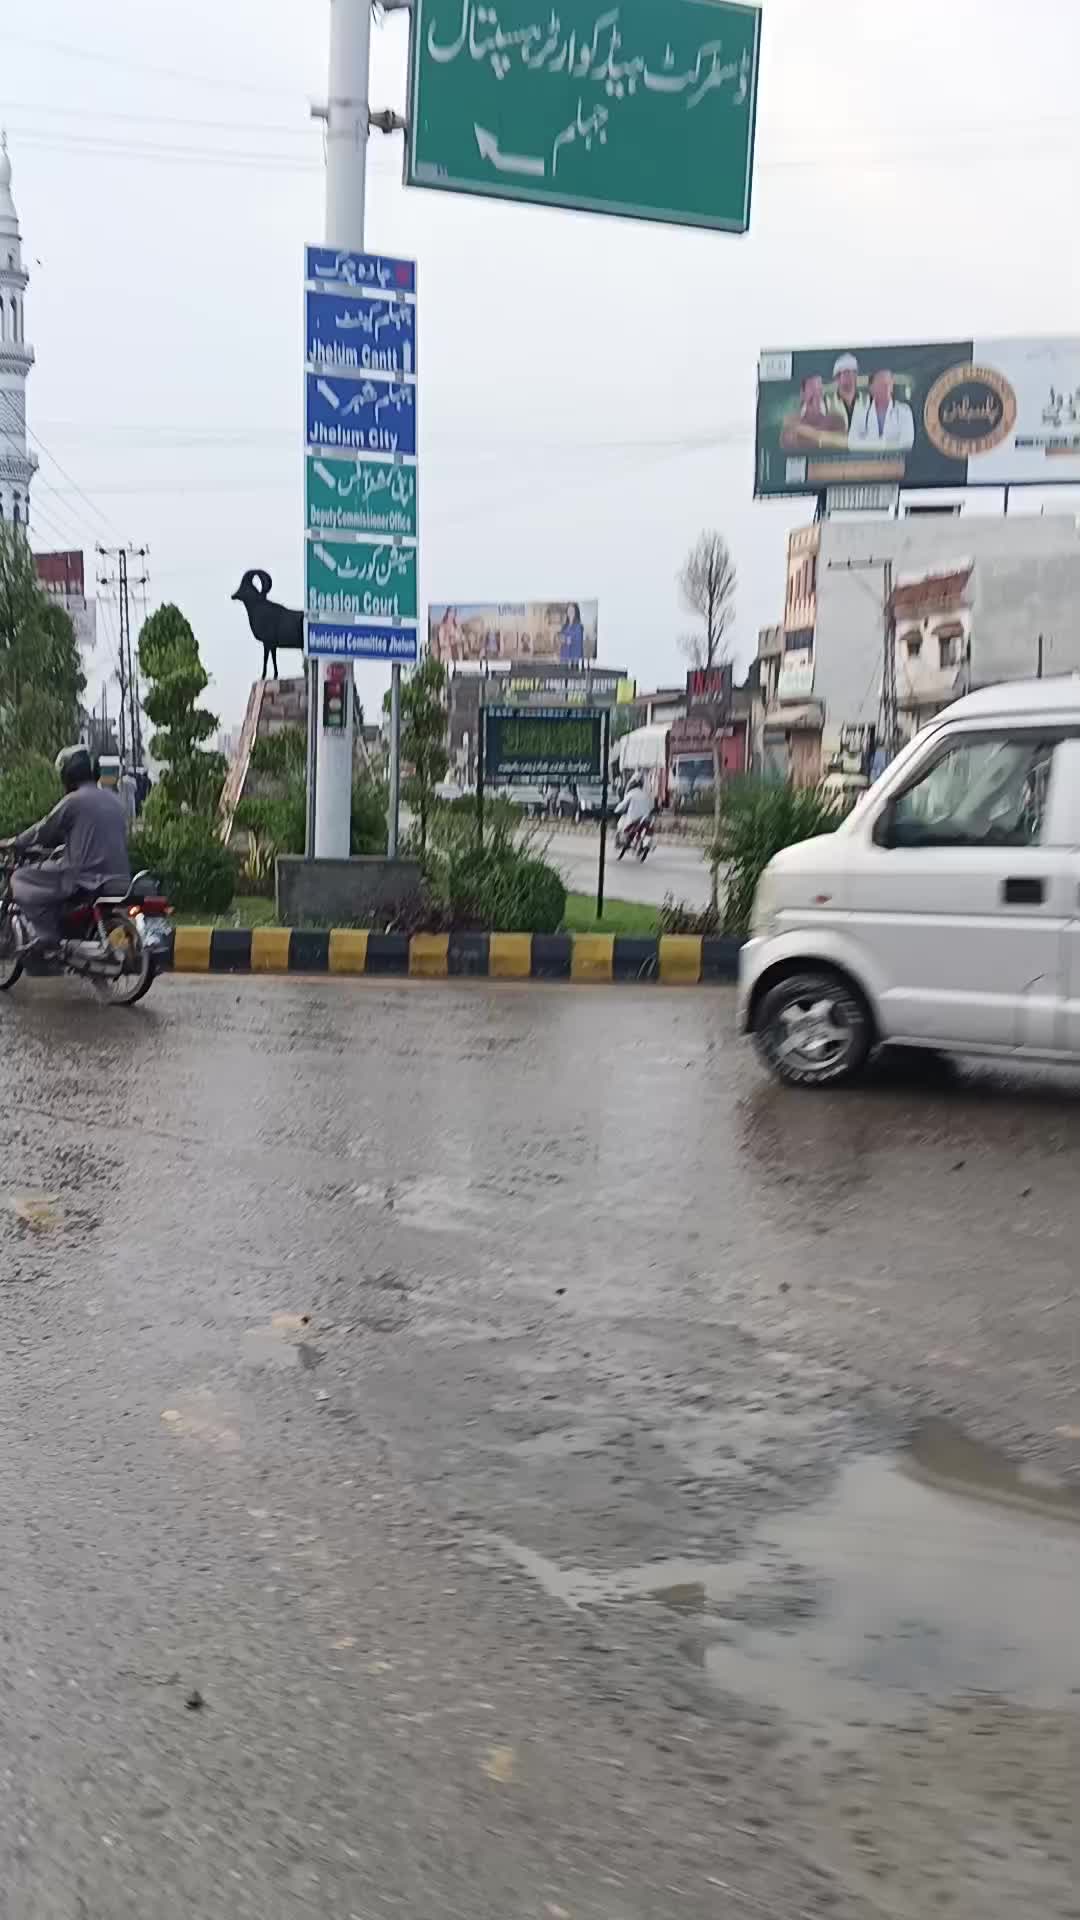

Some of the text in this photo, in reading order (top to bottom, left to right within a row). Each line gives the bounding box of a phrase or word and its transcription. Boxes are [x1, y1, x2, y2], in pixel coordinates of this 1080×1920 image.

[552, 97, 608, 176] جہلم
[309, 338, 358, 367] Jhelum
[309, 420, 398, 452] Jhelum City
[309, 586, 398, 617] Session Court
[309, 631, 346, 653] Municipal
[346, 632, 388, 651] Committee
